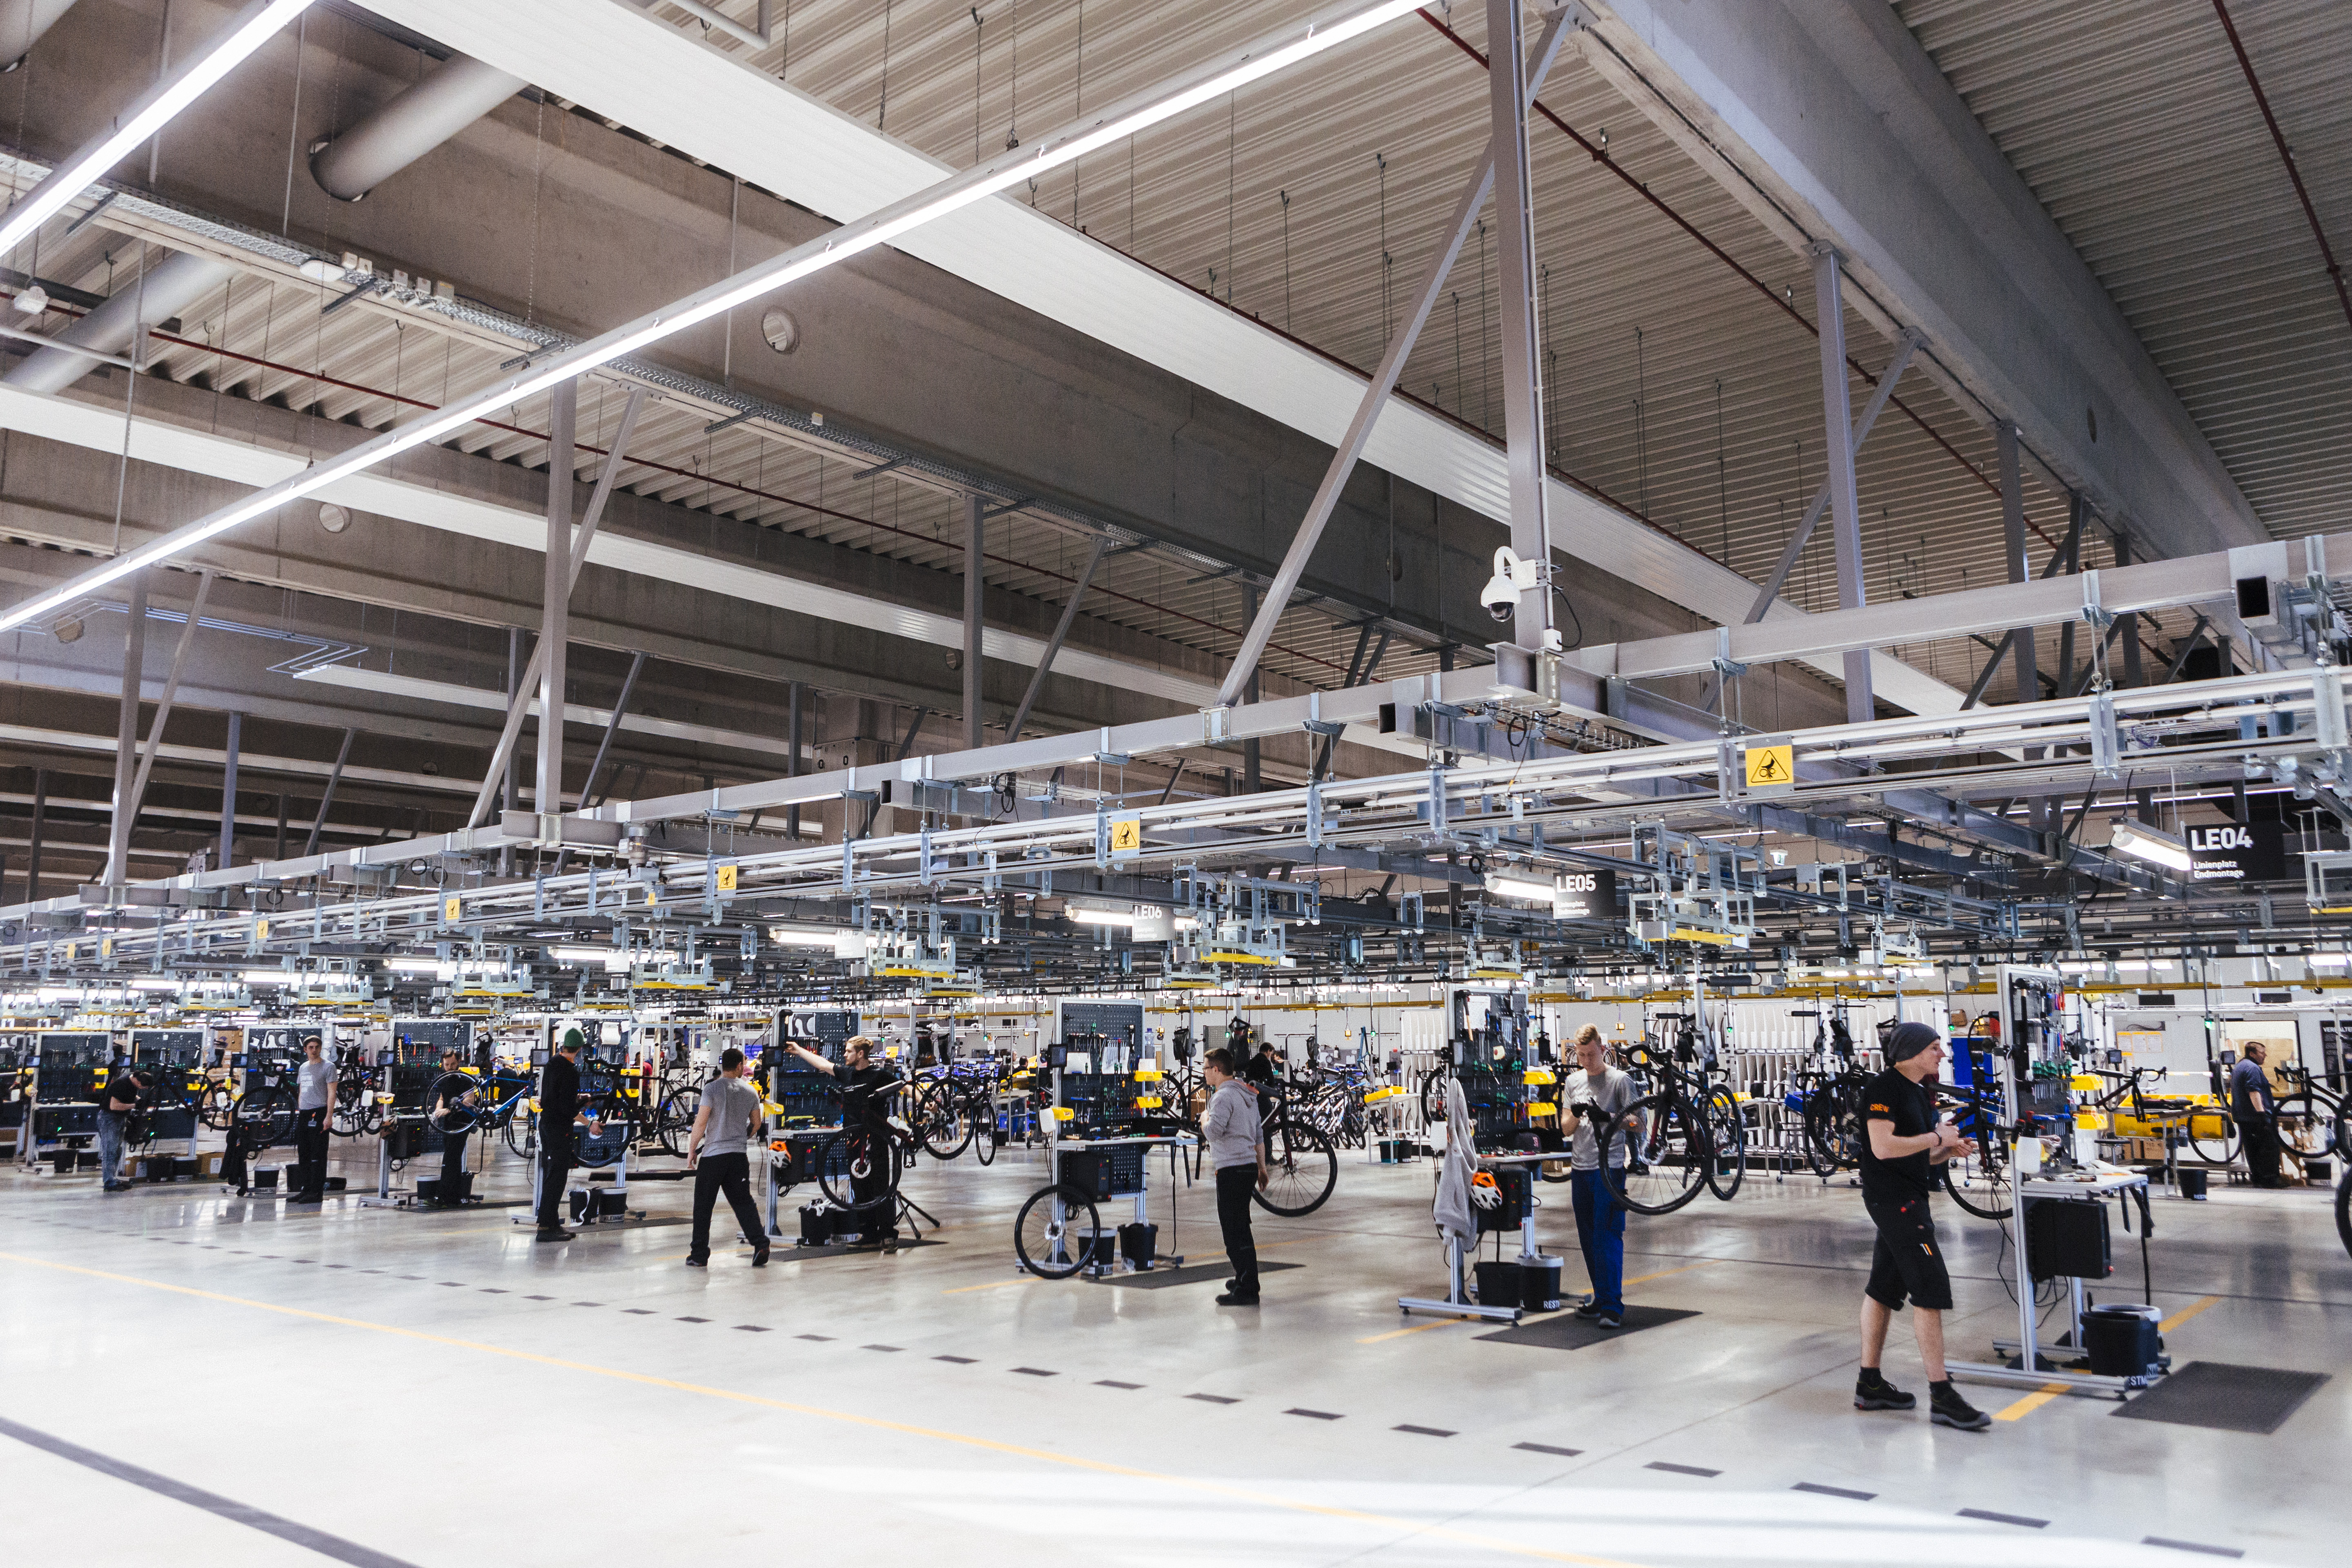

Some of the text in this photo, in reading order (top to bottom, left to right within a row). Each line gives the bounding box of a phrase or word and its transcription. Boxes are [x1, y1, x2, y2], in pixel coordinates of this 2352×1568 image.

[2191, 827, 2254, 851] LE04
[2194, 860, 2238, 870] Linienplatz
[2194, 869, 2245, 879] Endmontage
[1556, 874, 1596, 893] LE05
[1135, 905, 1162, 920] LE06
[1870, 1103, 1889, 1113] CREW
